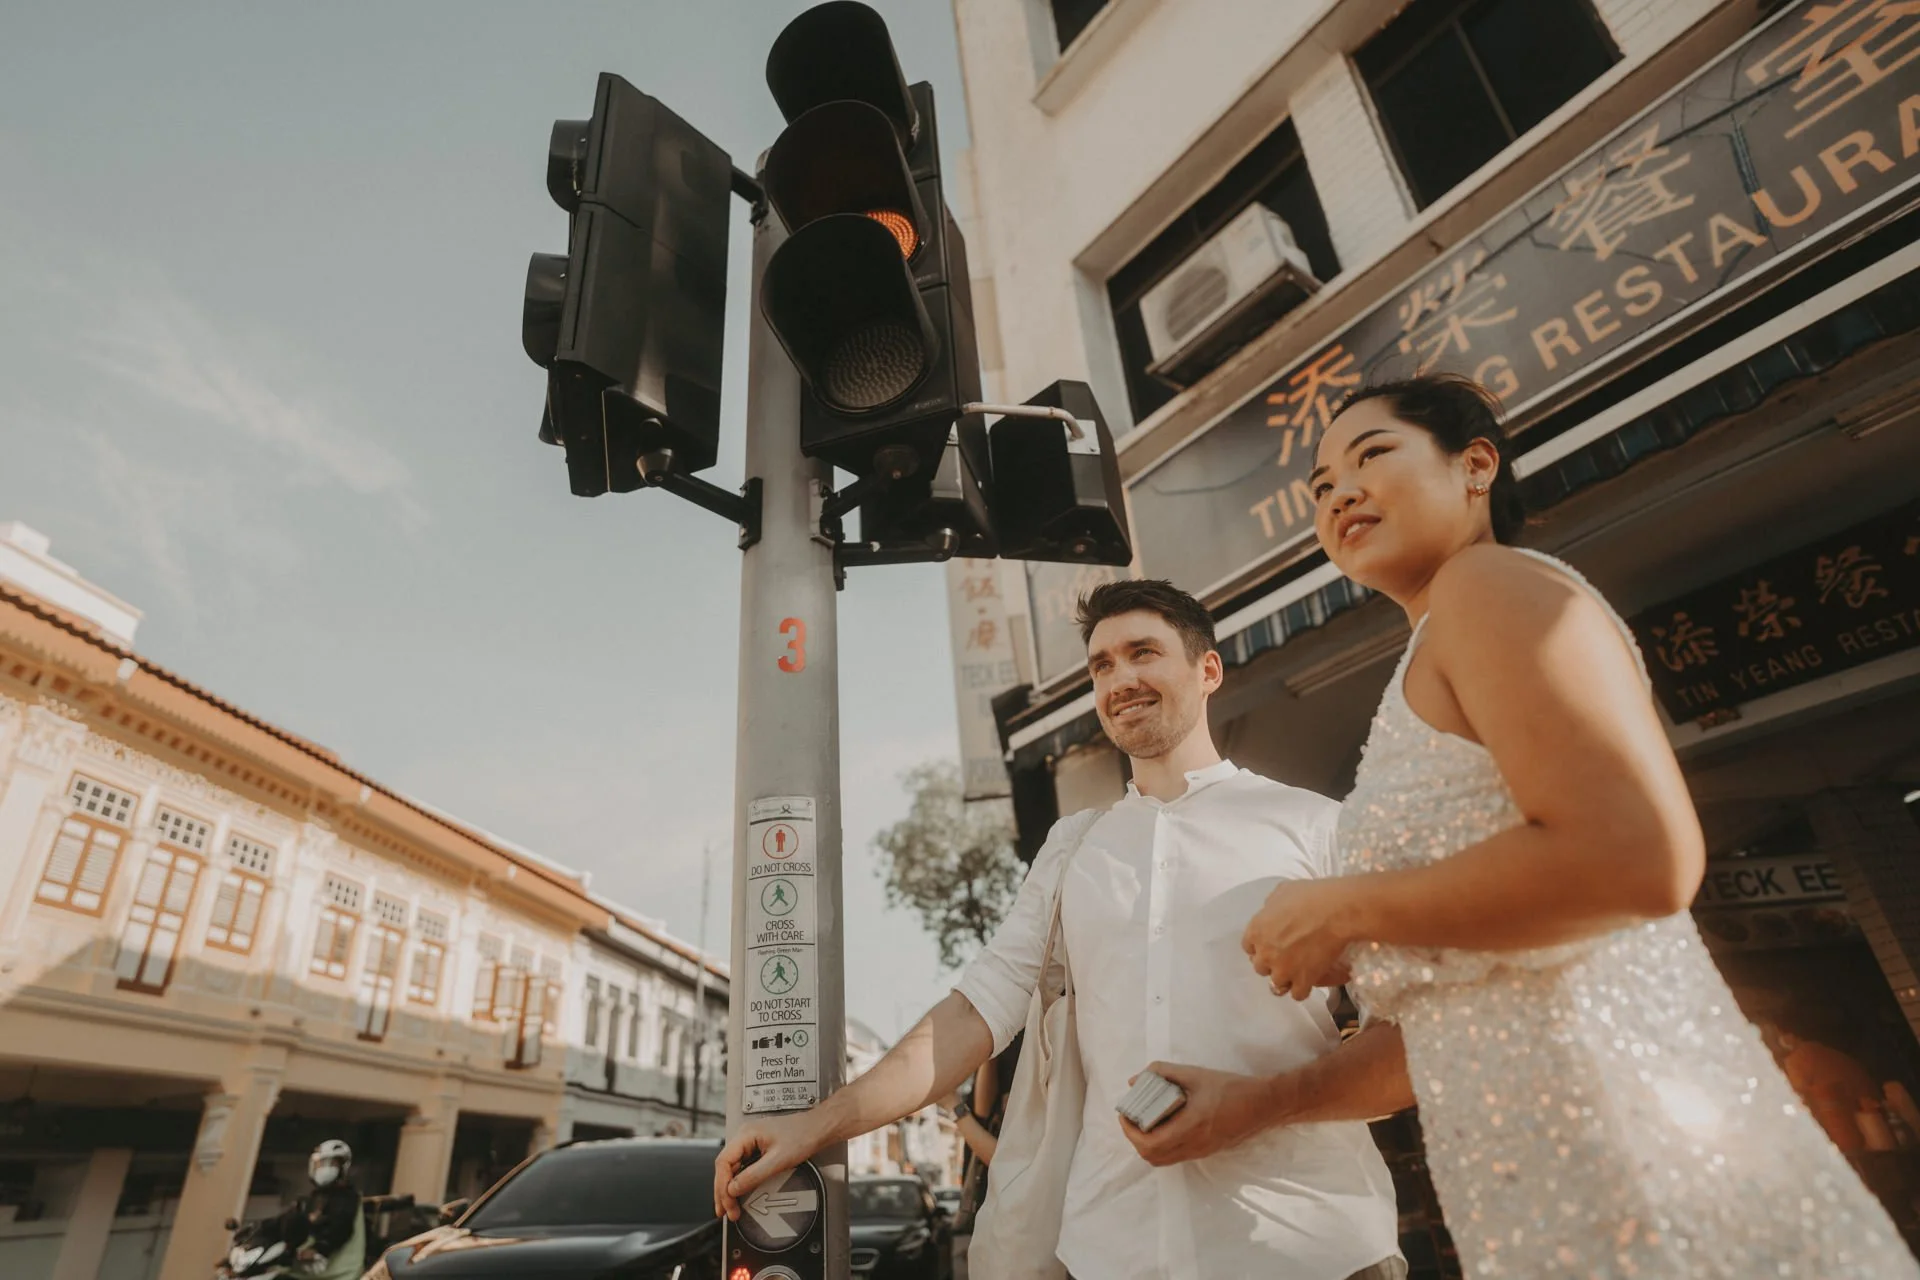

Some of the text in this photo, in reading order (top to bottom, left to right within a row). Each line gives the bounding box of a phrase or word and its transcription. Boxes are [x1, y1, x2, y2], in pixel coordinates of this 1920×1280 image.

[778, 616, 807, 673] 3
[1676, 680, 1720, 706] TIN
[1729, 643, 1822, 690] YEANG
[751, 862, 811, 876] DO NOT CROSS
[1792, 863, 1842, 893] EE
[765, 919, 795, 931] CROSS
[756, 930, 804, 943] WITH CARE
[750, 997, 811, 1012] DO NOT START
[758, 1009, 802, 1022] TO CROSS
[761, 1054, 800, 1067] Press For
[756, 1067, 805, 1080] Green Man
